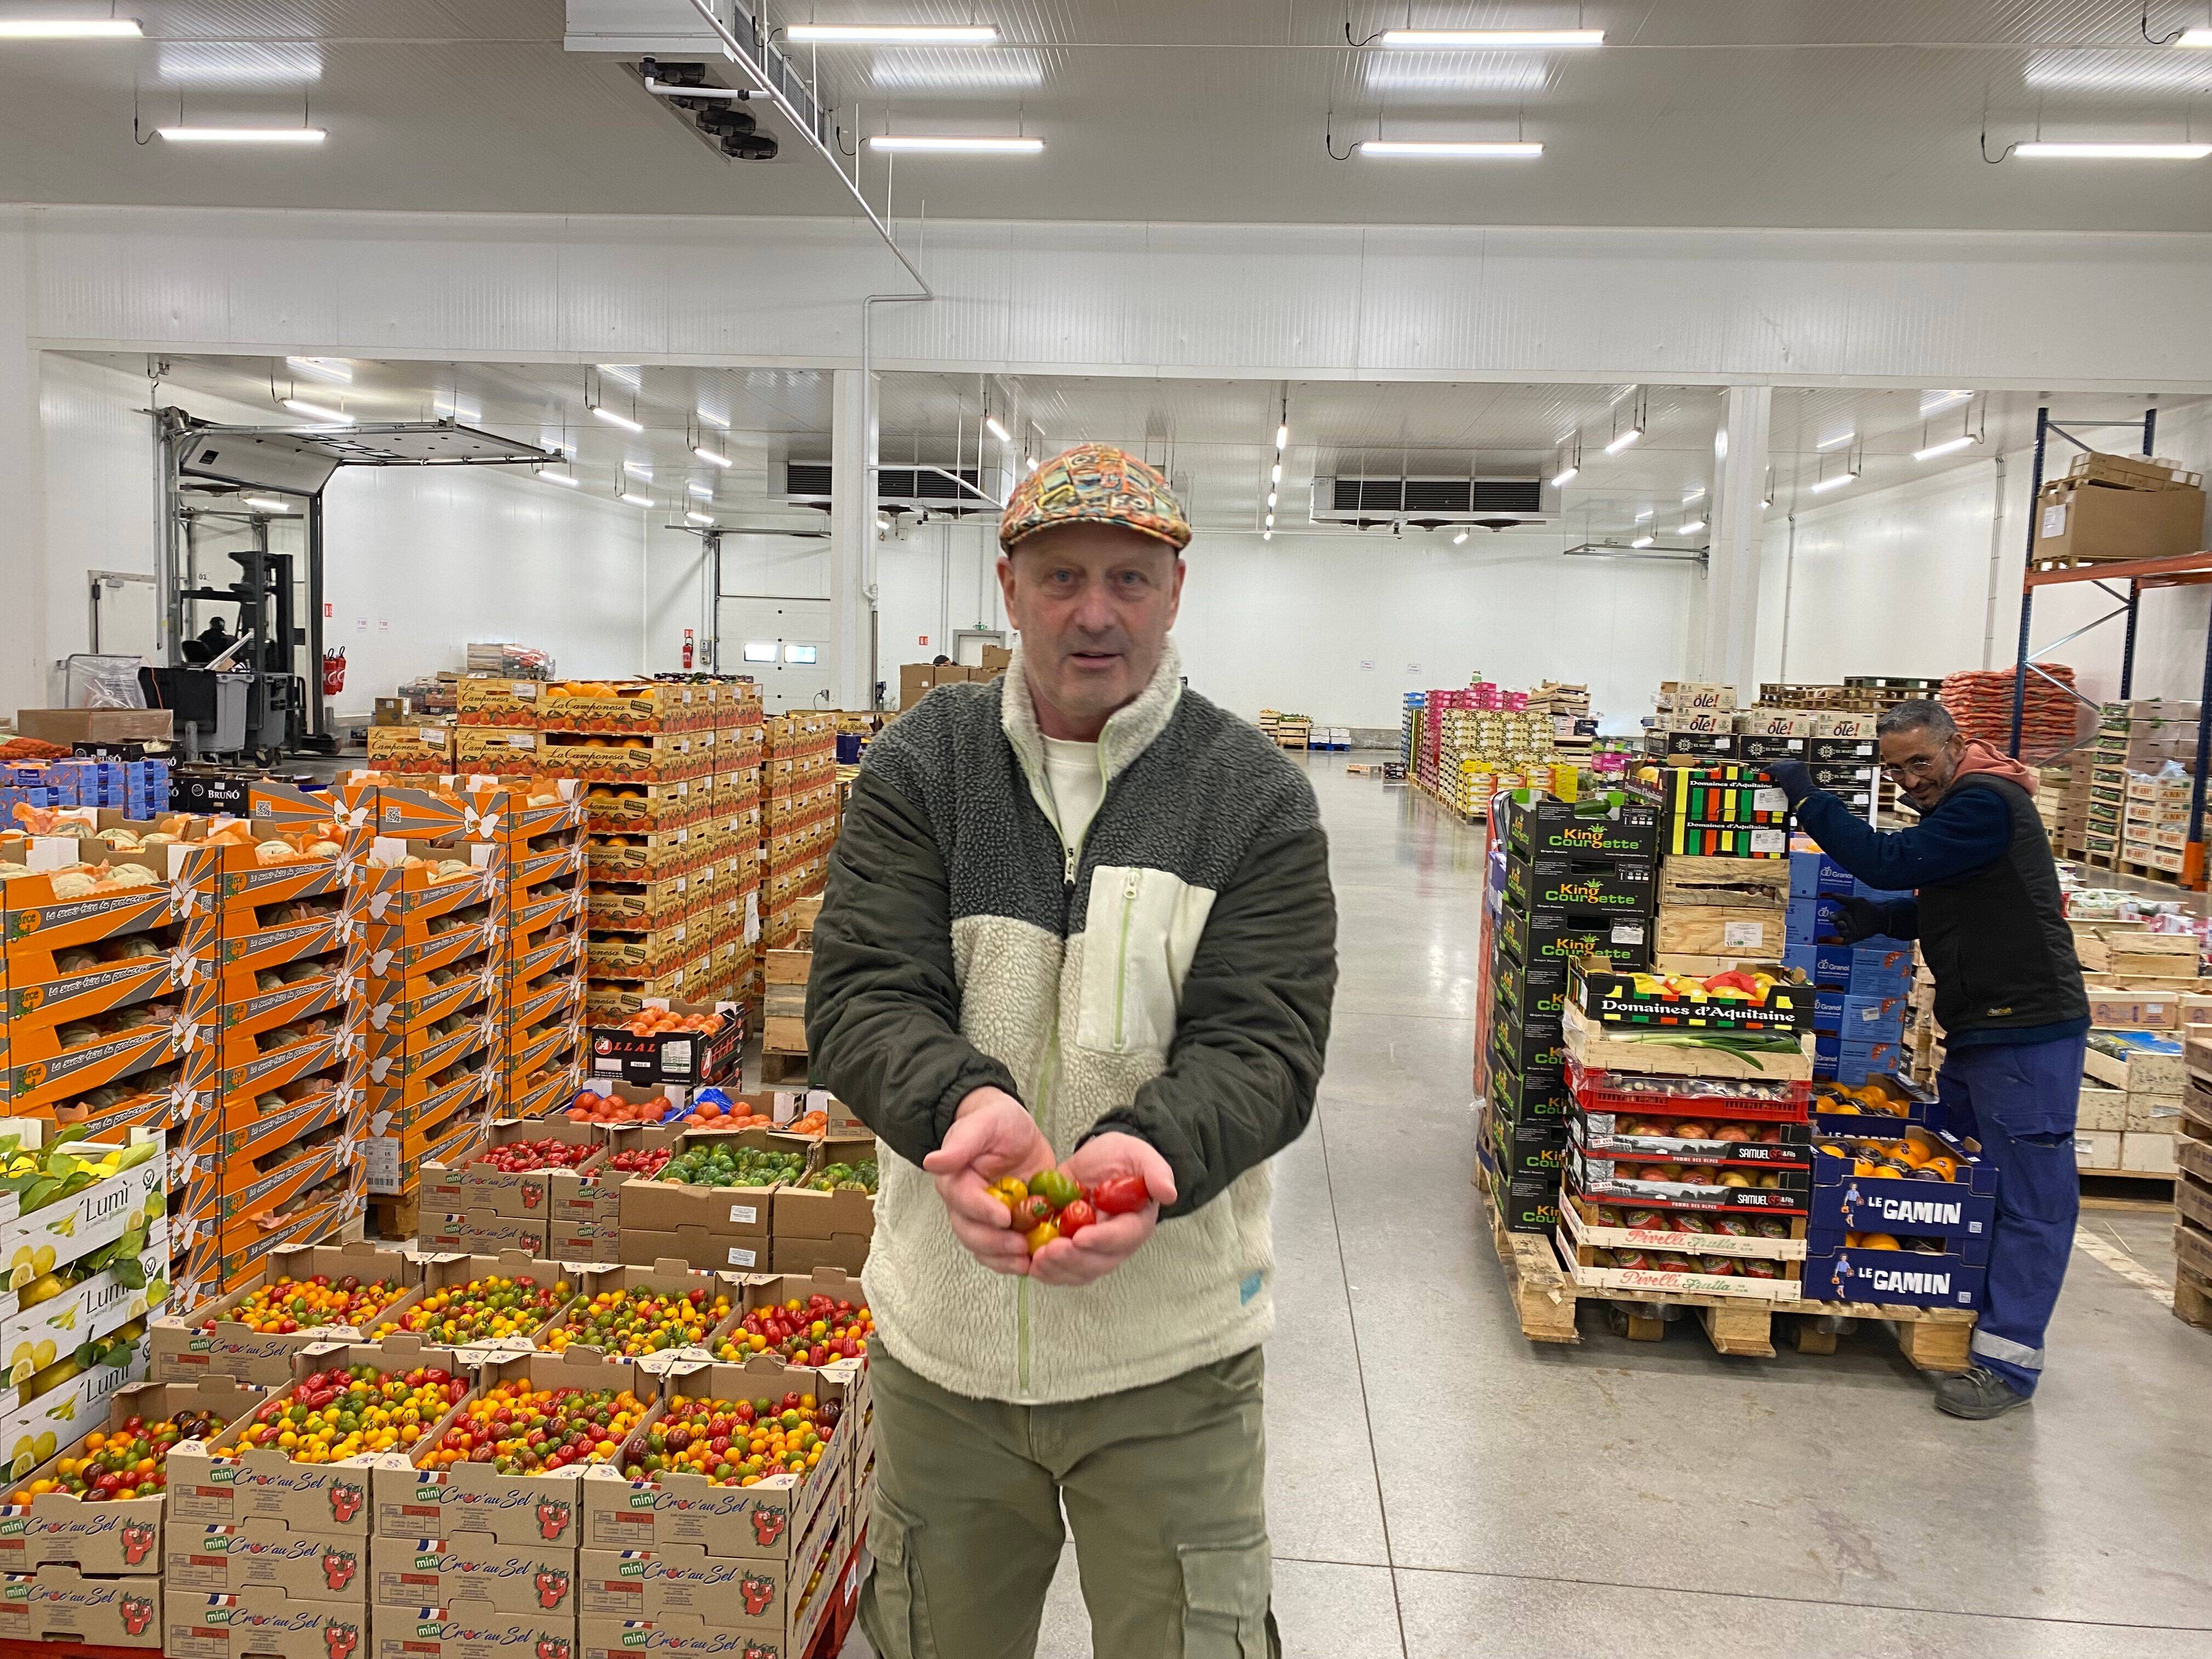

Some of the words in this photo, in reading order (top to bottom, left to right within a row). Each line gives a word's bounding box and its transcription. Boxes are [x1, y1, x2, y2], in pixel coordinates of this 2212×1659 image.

[462, 681, 475, 691] La
[462, 692, 509, 706] Camponesa
[549, 698, 565, 710] La
[564, 698, 625, 714] Camponesa
[372, 730, 384, 740] La
[462, 730, 475, 741] La
[372, 740, 419, 755] Camponesa
[462, 742, 510, 756] Camponesa
[548, 747, 563, 758] La
[563, 747, 624, 763] Camponesa
[208, 786, 240, 799] BRUÑÓ
[1549, 836, 1639, 849] Courgette
[1564, 828, 1603, 843] King
[1545, 890, 1635, 904] Courgette
[1560, 884, 1600, 898] King
[1556, 938, 1595, 952] King
[1601, 1000, 1690, 1015] Domaines
[1695, 1005, 1796, 1022] d'Aquitaine
[597, 1040, 656, 1052] ALLAL
[1739, 1148, 1770, 1159] SAMUEL
[447, 1174, 461, 1182] mini
[1737, 1194, 1768, 1205] SAMUEL
[1869, 1197, 1883, 1207] LE
[1883, 1200, 1961, 1224] GAMIN
[1626, 1230, 1686, 1246] Pivelli
[1620, 1271, 1681, 1287] Pivelli
[1858, 1267, 1872, 1278] LE
[1874, 1271, 1951, 1295] GAMIN
[191, 1339, 209, 1350] mini
[259, 1342, 288, 1358] Sel
[211, 1470, 234, 1482] mini
[293, 1472, 328, 1491] Sel
[417, 1488, 440, 1500] mini
[500, 1489, 534, 1509] Sel
[631, 1494, 654, 1506] mini
[714, 1496, 750, 1515] Sel
[1, 1520, 24, 1534] mini
[86, 1515, 120, 1536] Sel
[205, 1538, 228, 1550] mini
[286, 1541, 320, 1559] Sel
[416, 1556, 438, 1568] mini
[498, 1558, 533, 1577] Sel
[621, 1562, 644, 1576] mini
[704, 1565, 738, 1585] Sel
[6, 1585, 27, 1599] mini
[84, 1585, 117, 1606] Sel
[207, 1610, 229, 1622] mini
[288, 1612, 323, 1631] Sel
[418, 1624, 441, 1636] mini
[500, 1626, 534, 1645] Sel
[624, 1632, 647, 1645] mini
[706, 1634, 741, 1654] Sel
